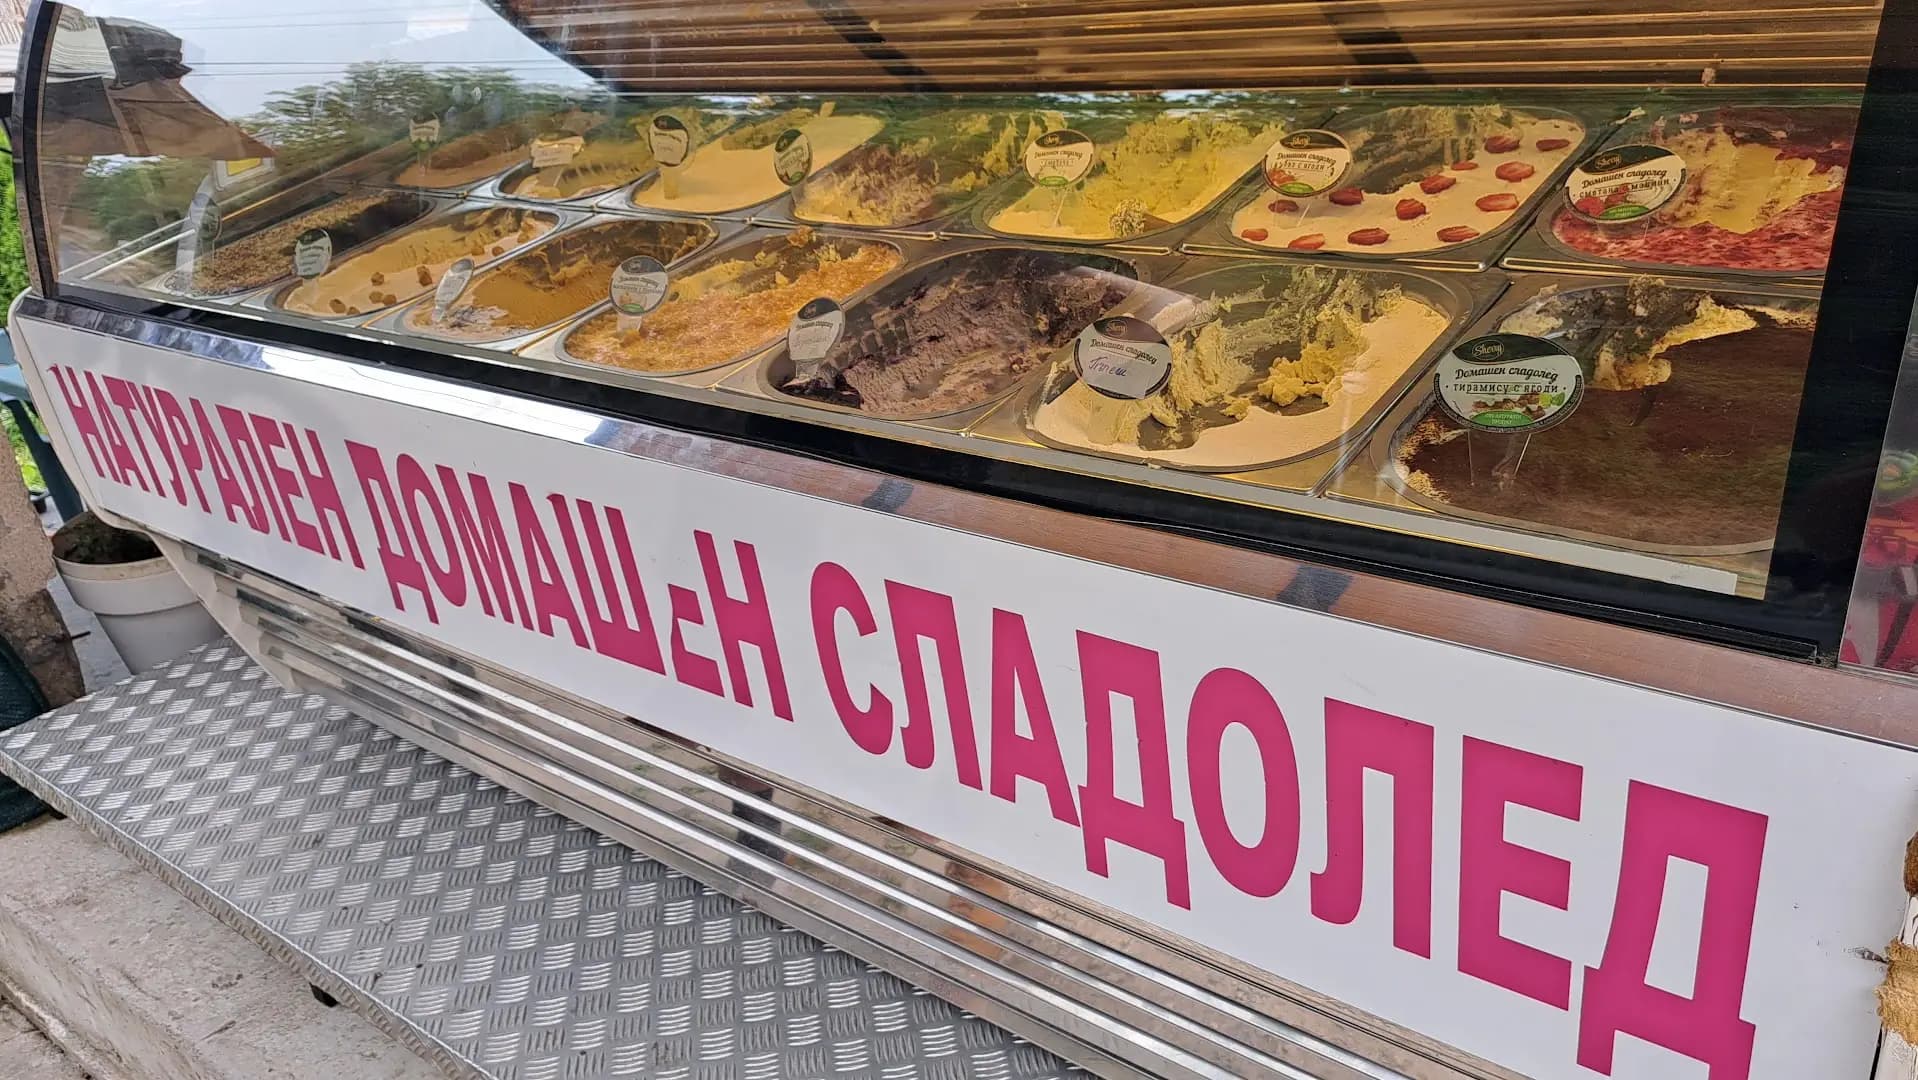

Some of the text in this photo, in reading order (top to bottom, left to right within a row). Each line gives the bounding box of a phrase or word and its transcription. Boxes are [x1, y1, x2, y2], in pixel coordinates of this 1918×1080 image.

[1582, 168, 1667, 189] Домашен сладолед
[1455, 366, 1559, 384] Домашен сладолед
[1453, 384, 1559, 395] тирамису с ягоди
[47, 363, 1768, 1080] НАТУРАЛЕН ДОМАШЕН СЛАДОЛЕД
